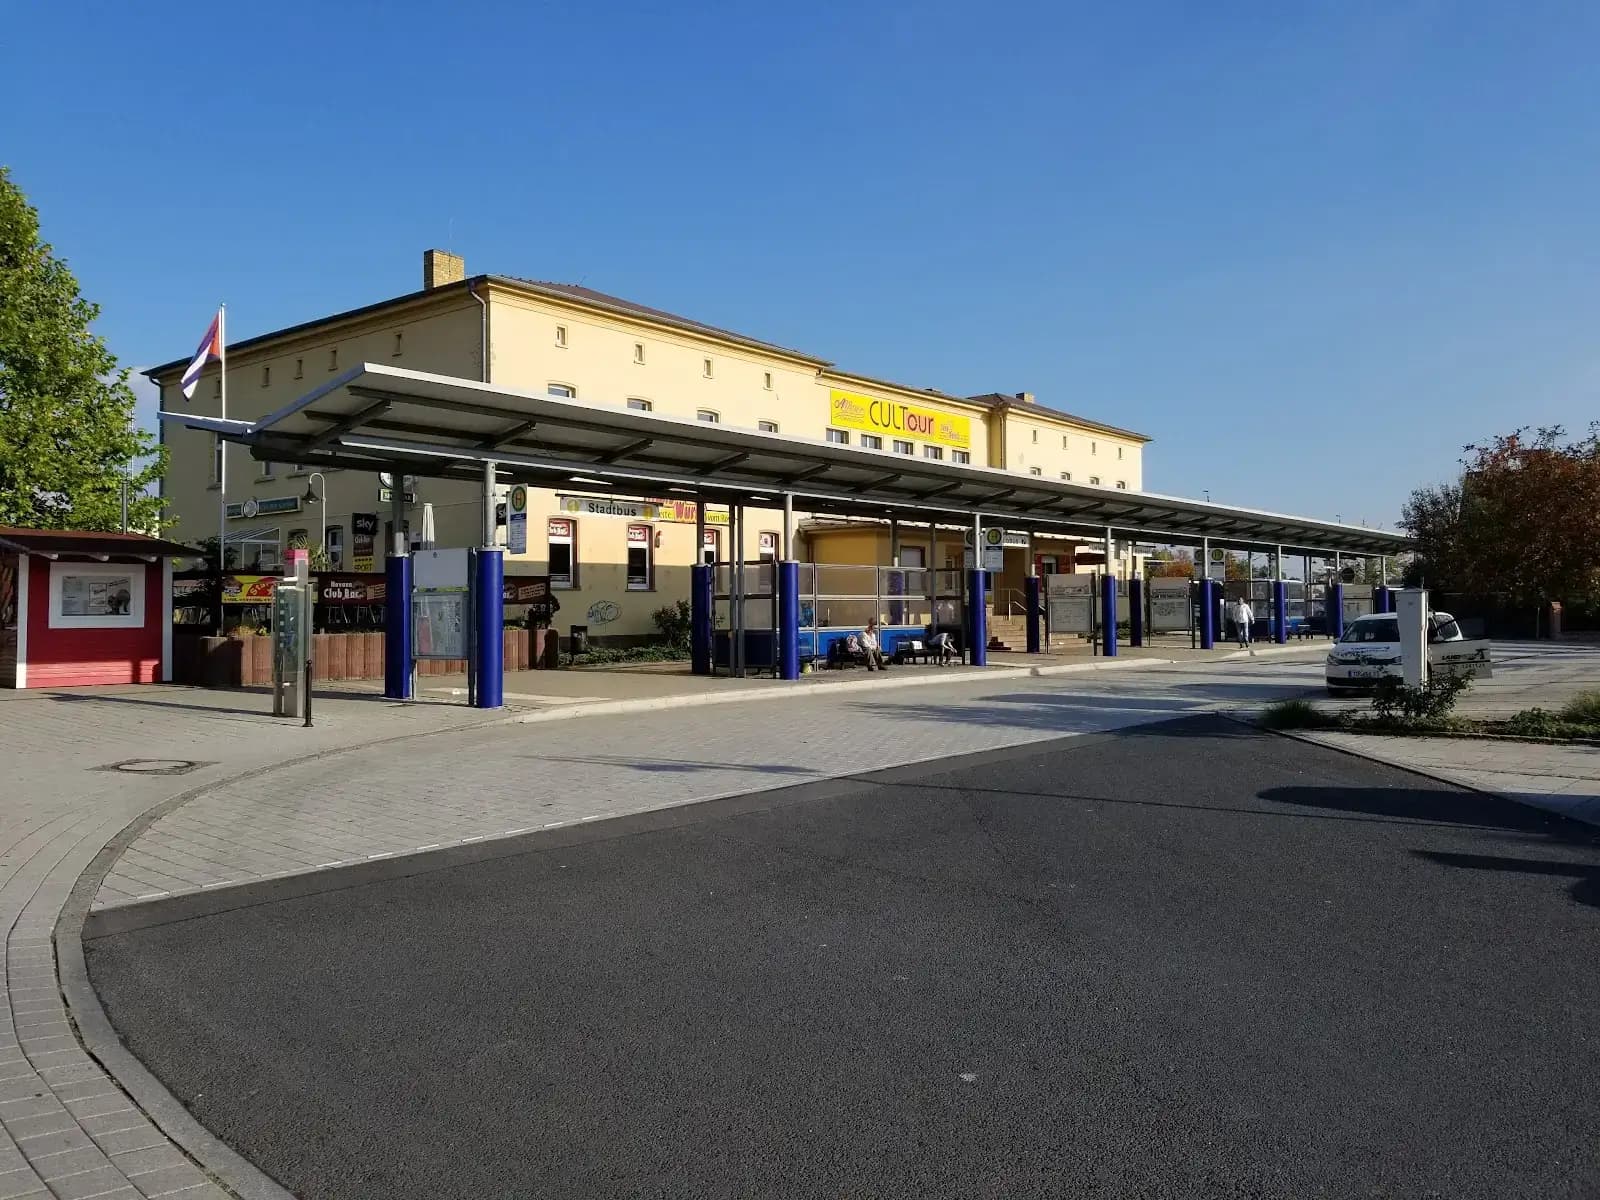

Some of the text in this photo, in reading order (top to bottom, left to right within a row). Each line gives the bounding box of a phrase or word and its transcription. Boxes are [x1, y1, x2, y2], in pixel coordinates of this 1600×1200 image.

[869, 400, 934, 435] CULTour
[588, 502, 637, 517] Stadtbus
[356, 518, 374, 530] sky
[323, 588, 343, 598] Club
